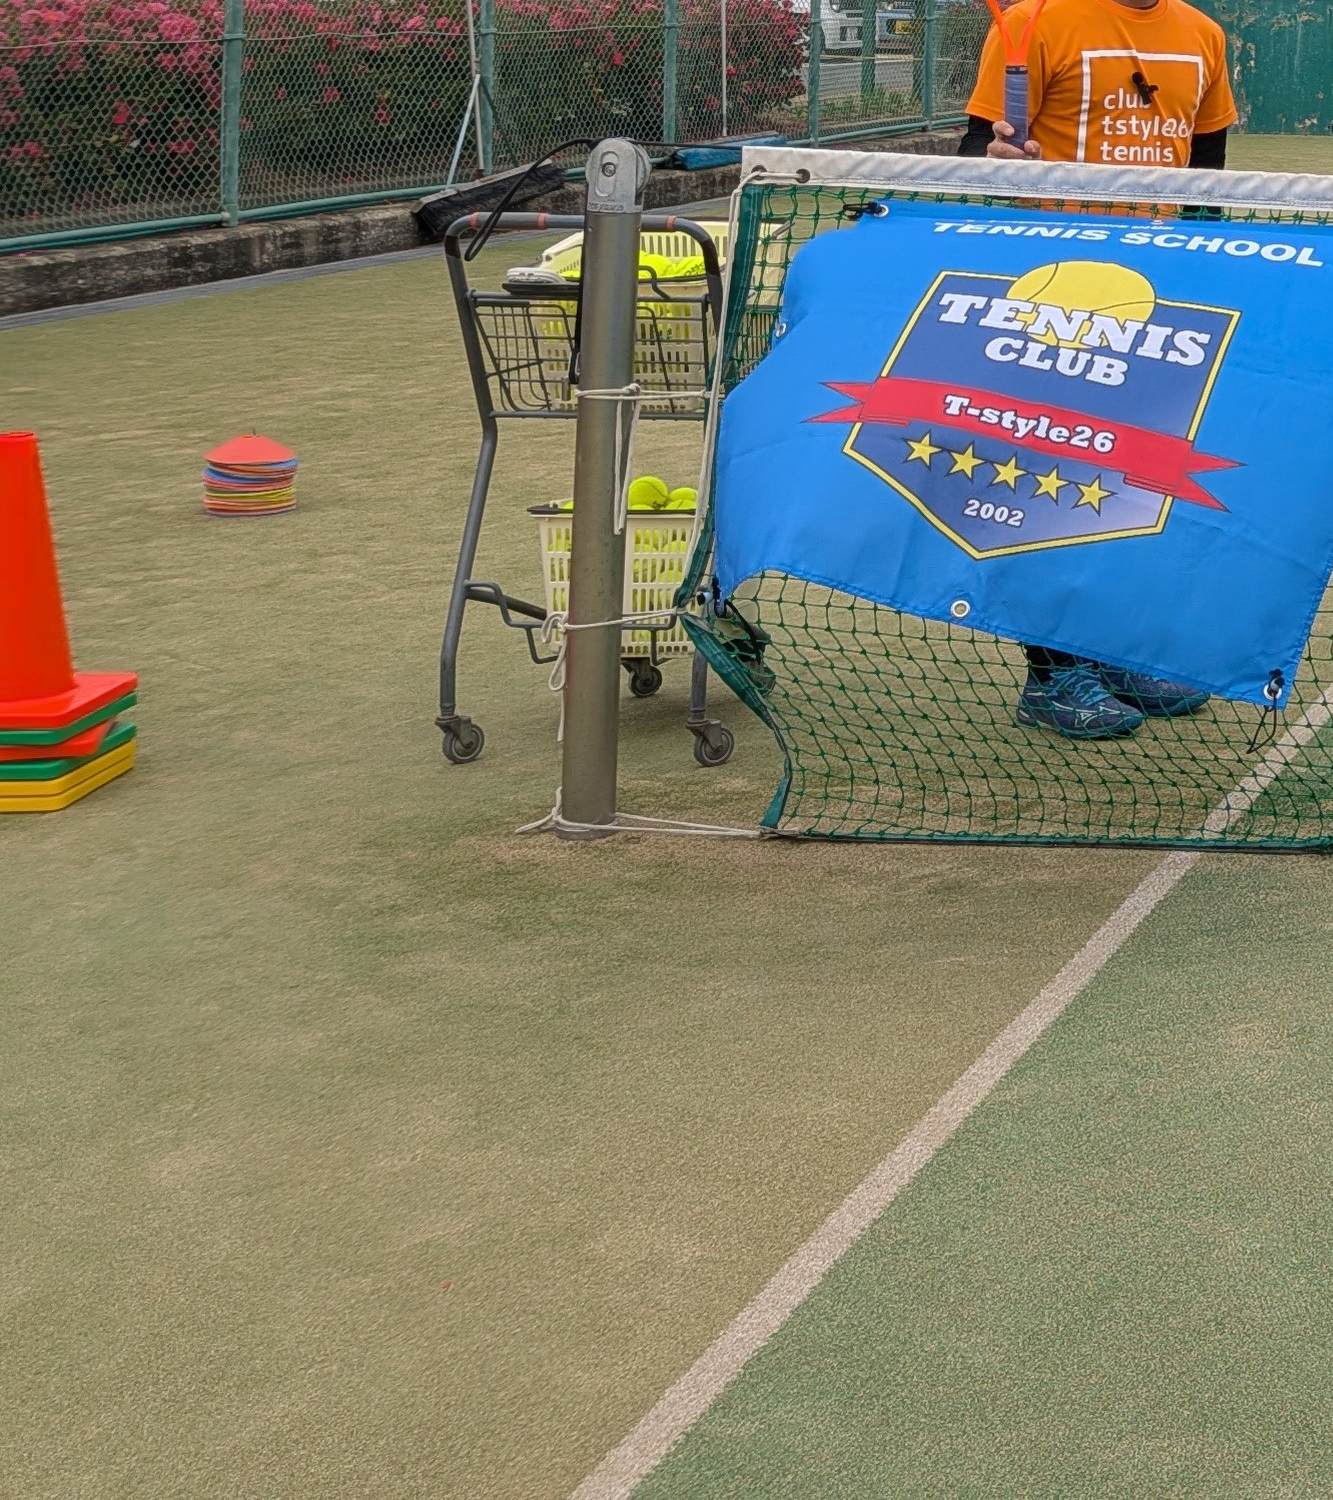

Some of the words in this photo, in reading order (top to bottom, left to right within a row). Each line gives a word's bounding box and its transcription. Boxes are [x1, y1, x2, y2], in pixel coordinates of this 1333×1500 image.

[1100, 141, 1174, 162] tennis
[933, 221, 1111, 241] TENNIS
[1119, 231, 1323, 267] SCHOOL
[937, 292, 1211, 368] TENNIS
[984, 337, 1126, 388] CLUB
[943, 396, 1116, 454] T-style26
[962, 499, 1025, 528] 2002
